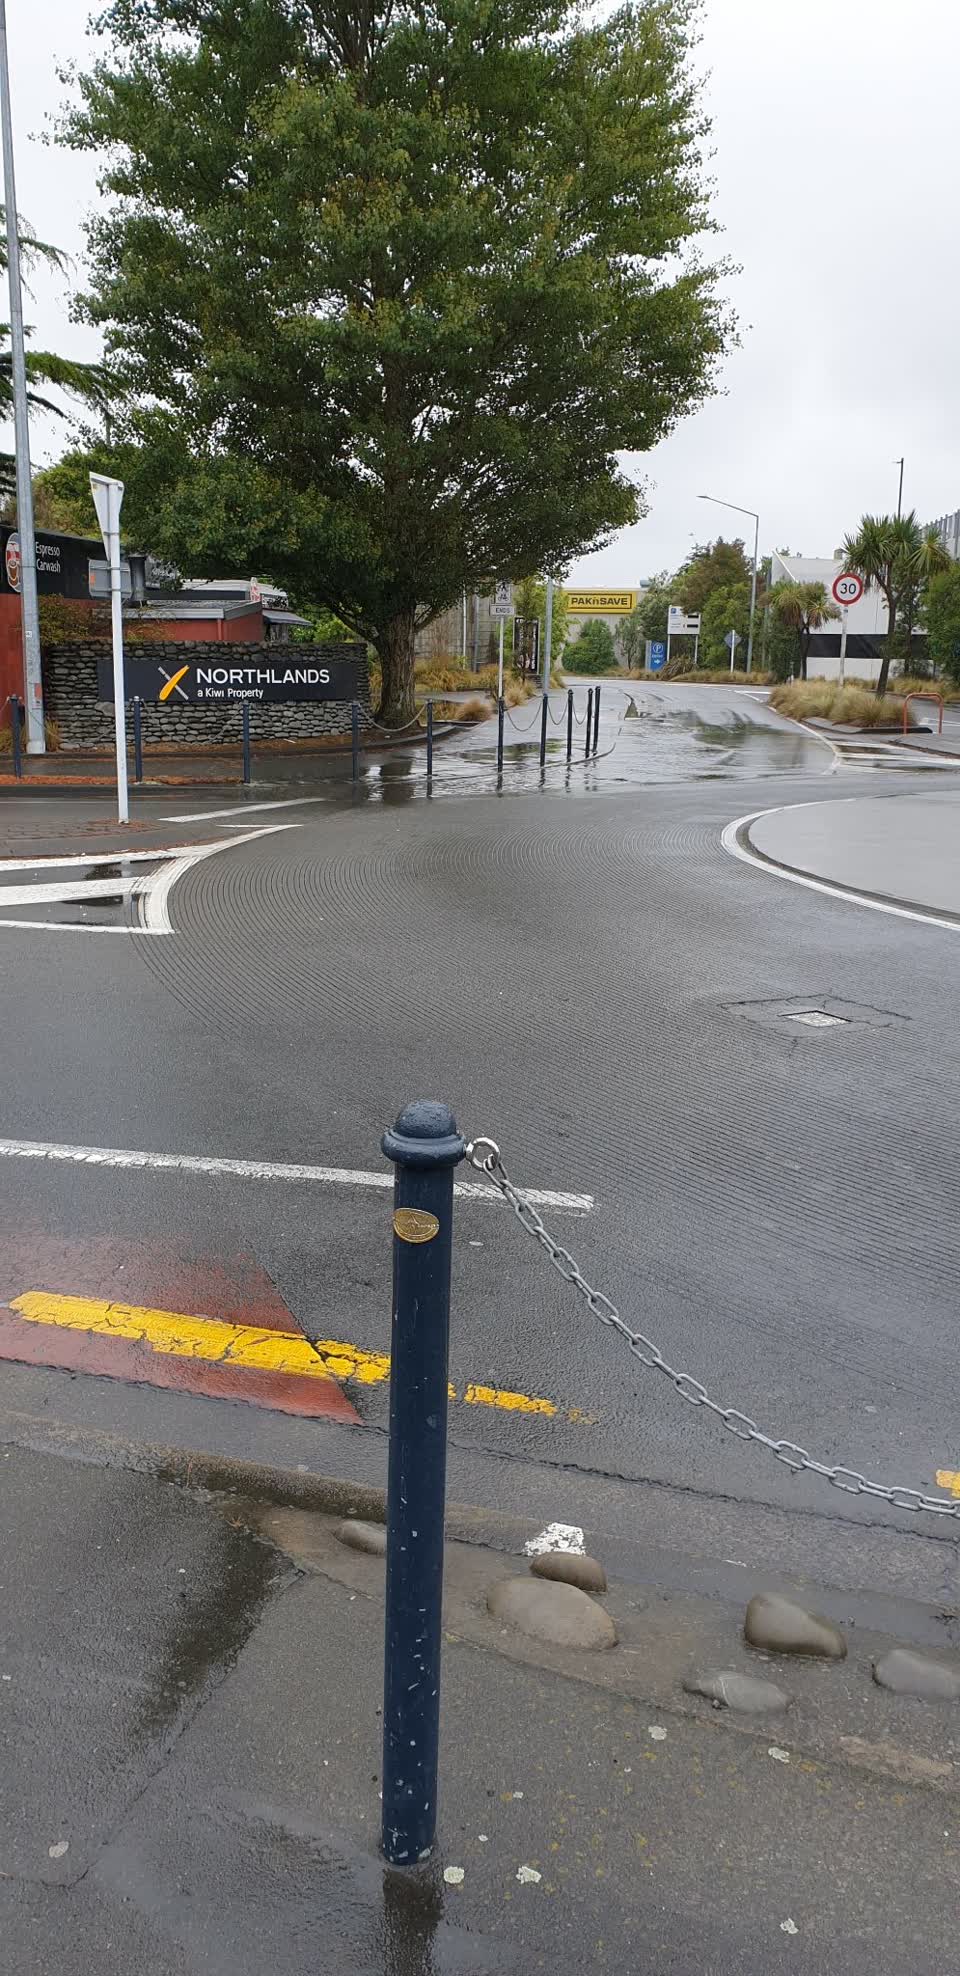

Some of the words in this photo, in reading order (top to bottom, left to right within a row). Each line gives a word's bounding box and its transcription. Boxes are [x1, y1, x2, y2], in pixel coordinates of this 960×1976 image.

[35, 541, 60, 558] Espresso
[36, 558, 61, 573] Carwash
[840, 583, 857, 594] 30
[196, 668, 330, 684] NORTHLANDS
[197, 690, 203, 698] a
[205, 688, 224, 698] Kiwi
[227, 688, 264, 699] Property
